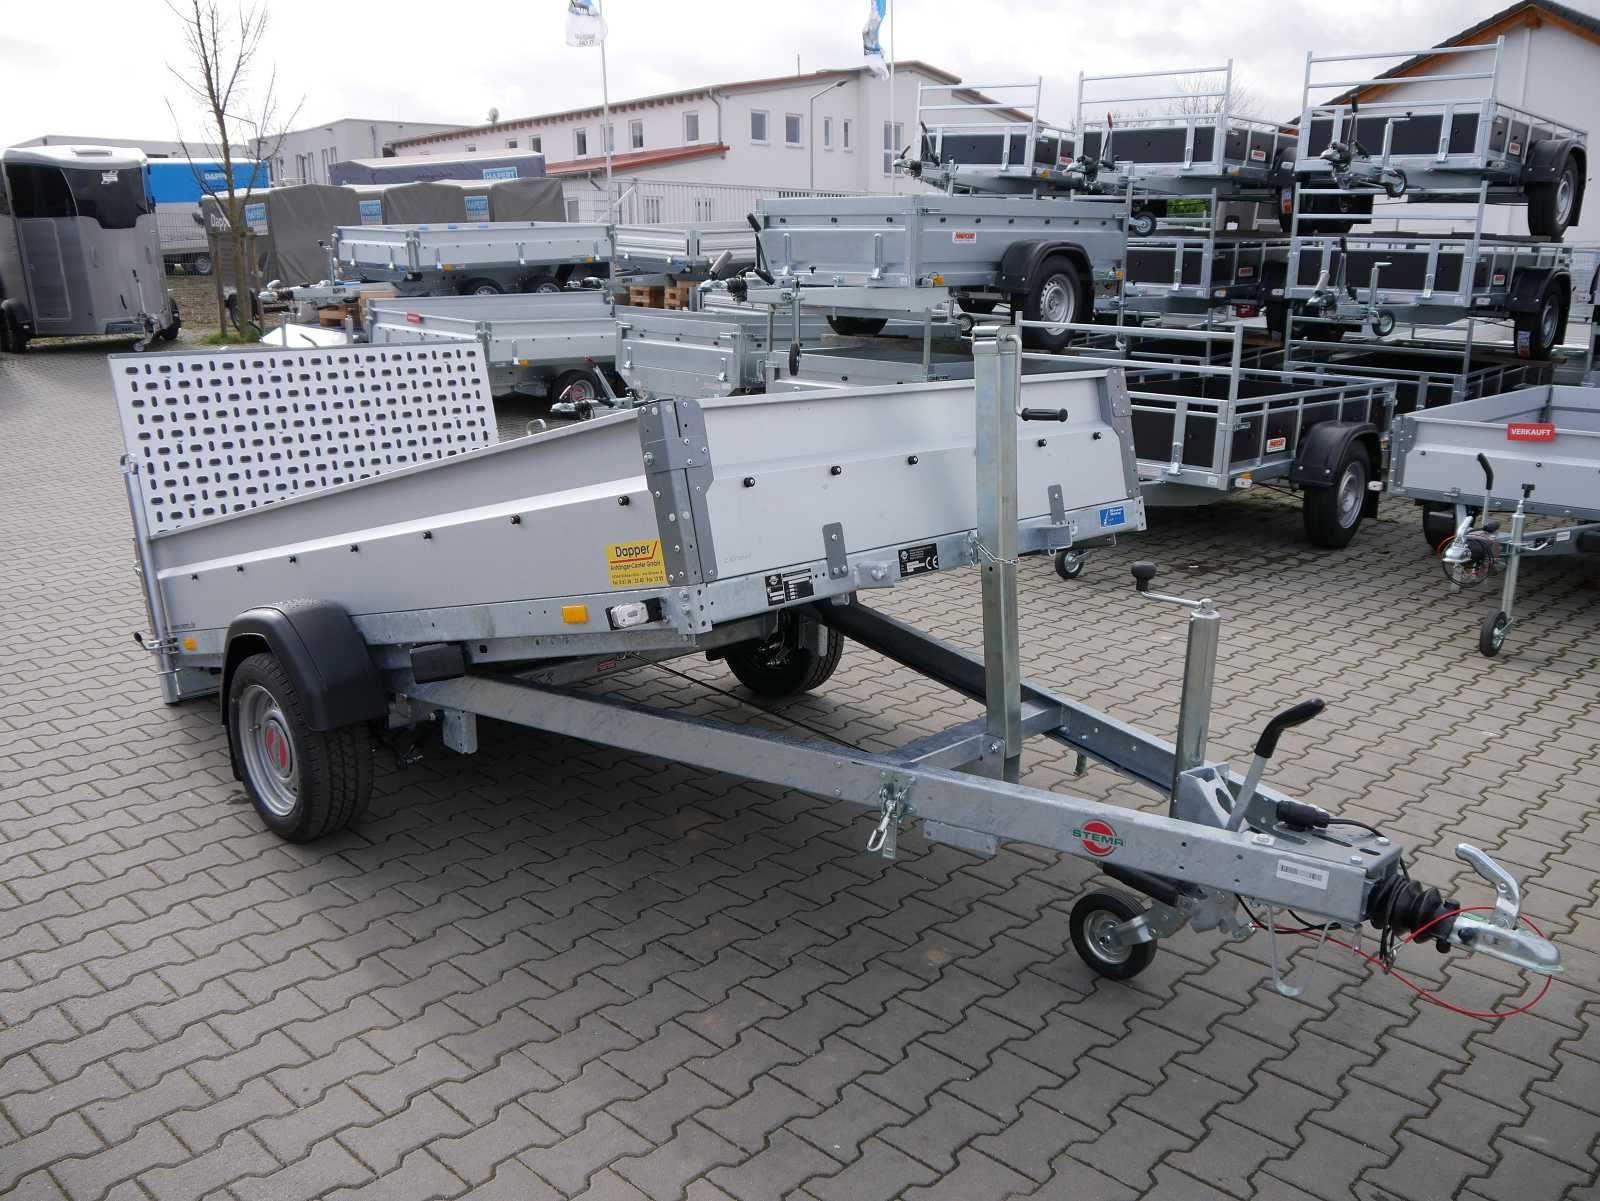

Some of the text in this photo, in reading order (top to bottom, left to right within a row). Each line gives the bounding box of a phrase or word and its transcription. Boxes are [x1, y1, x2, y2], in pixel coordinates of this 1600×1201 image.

[1511, 428, 1552, 436] VERKAUFT
[615, 545, 650, 558] Dapper
[925, 555, 939, 570] CE
[1072, 829, 1124, 846] STEMA
